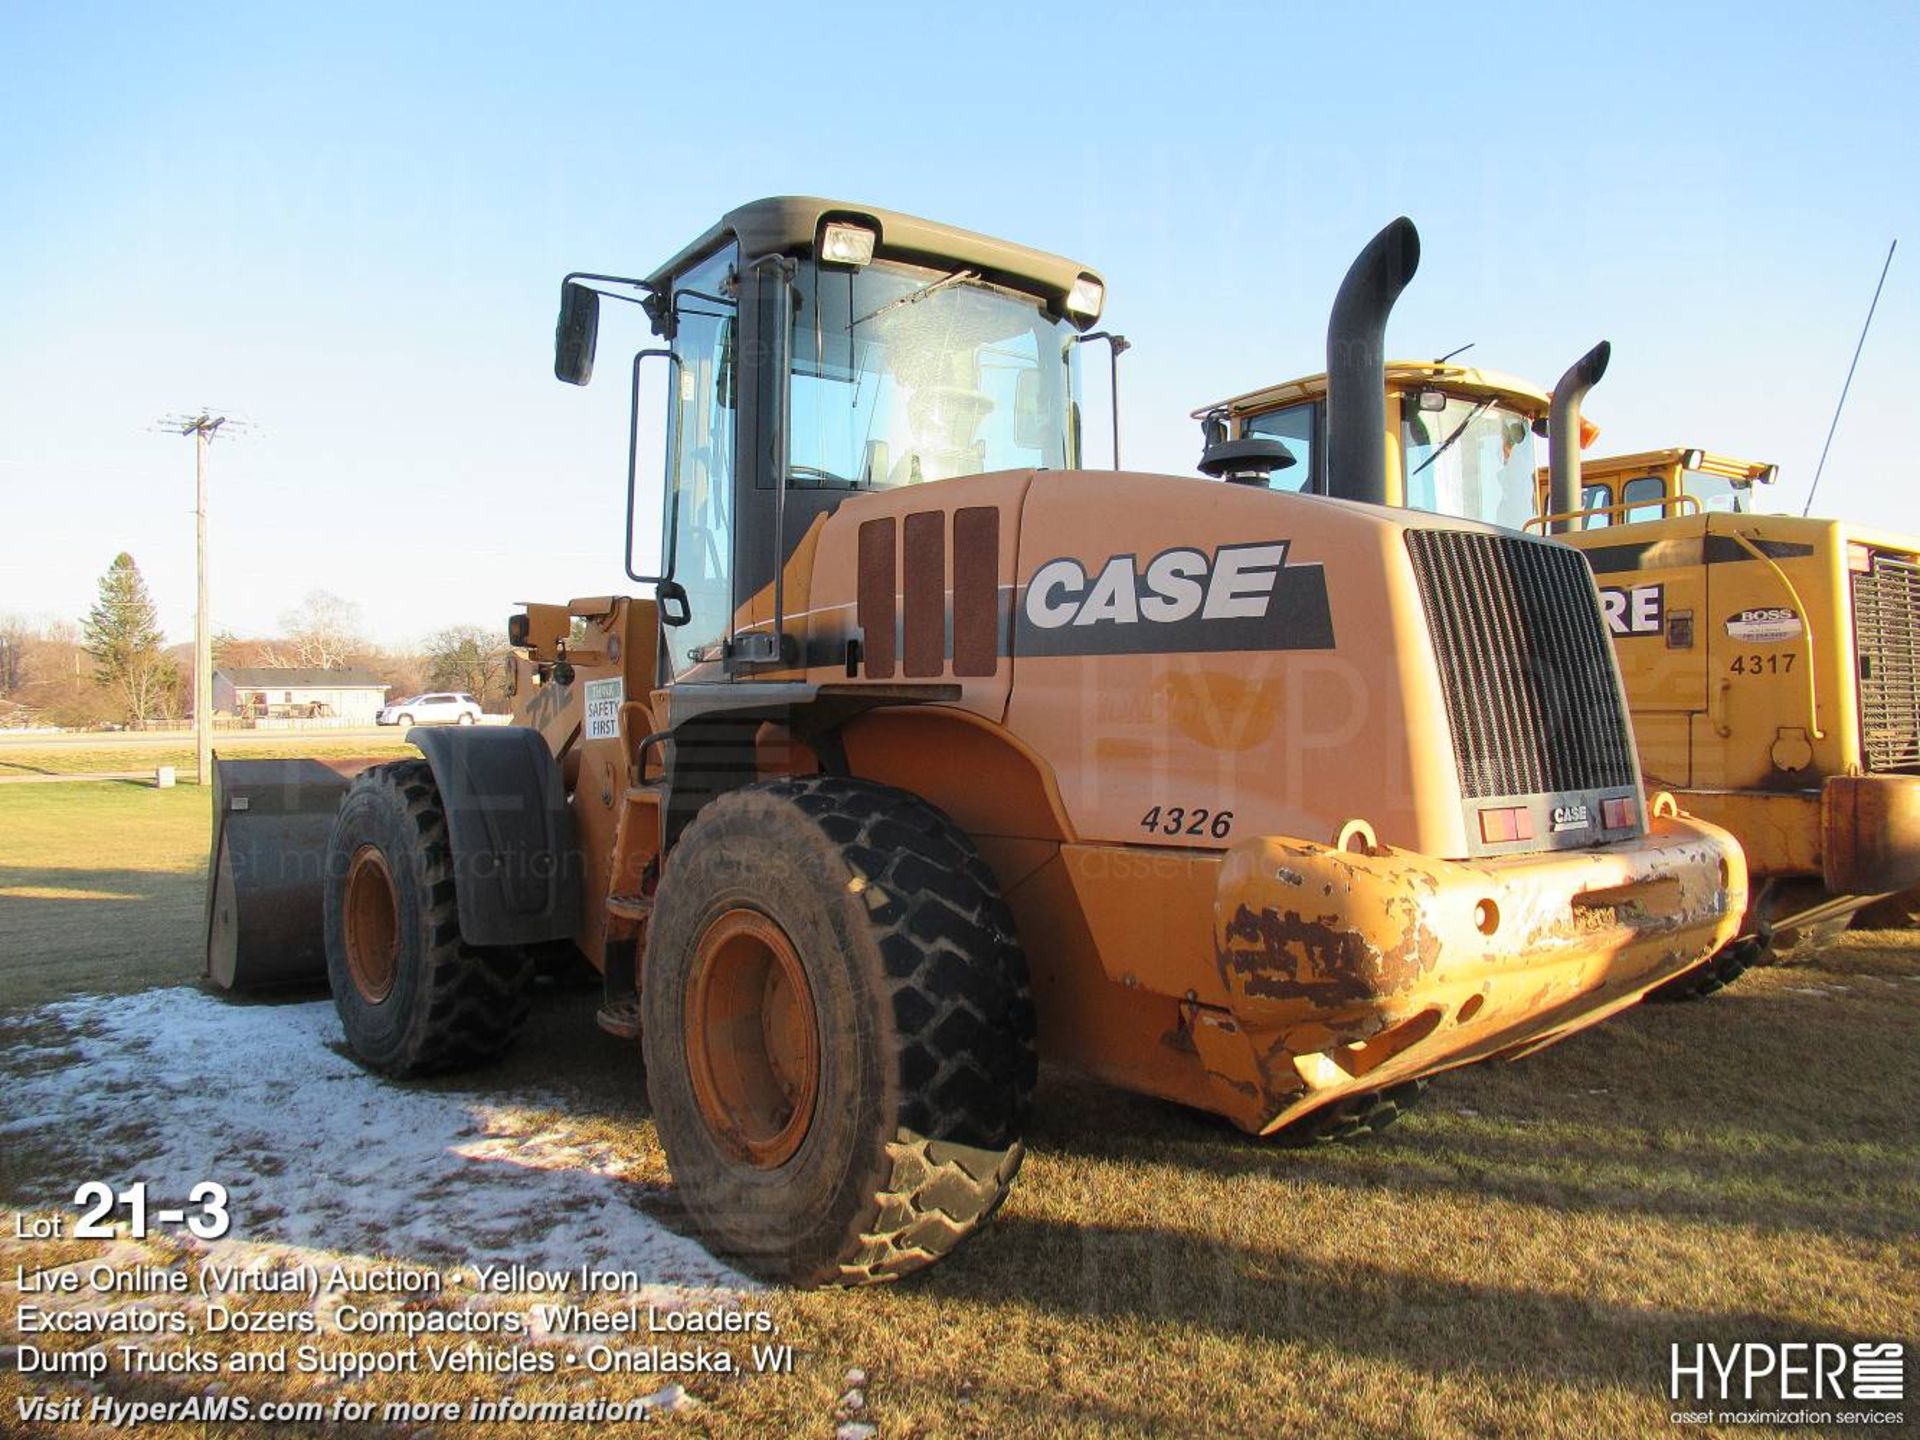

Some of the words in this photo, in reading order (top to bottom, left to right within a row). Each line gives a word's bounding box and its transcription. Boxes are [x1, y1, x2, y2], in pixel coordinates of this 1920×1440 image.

[1025, 541, 1288, 630] CASE
[1741, 608, 1793, 622] BOSS
[1730, 653, 1796, 675] 4317
[588, 700, 620, 717] SAFETY
[592, 719, 616, 736] FIRST
[1140, 805, 1234, 840] 4326
[1554, 805, 1587, 823] CASE
